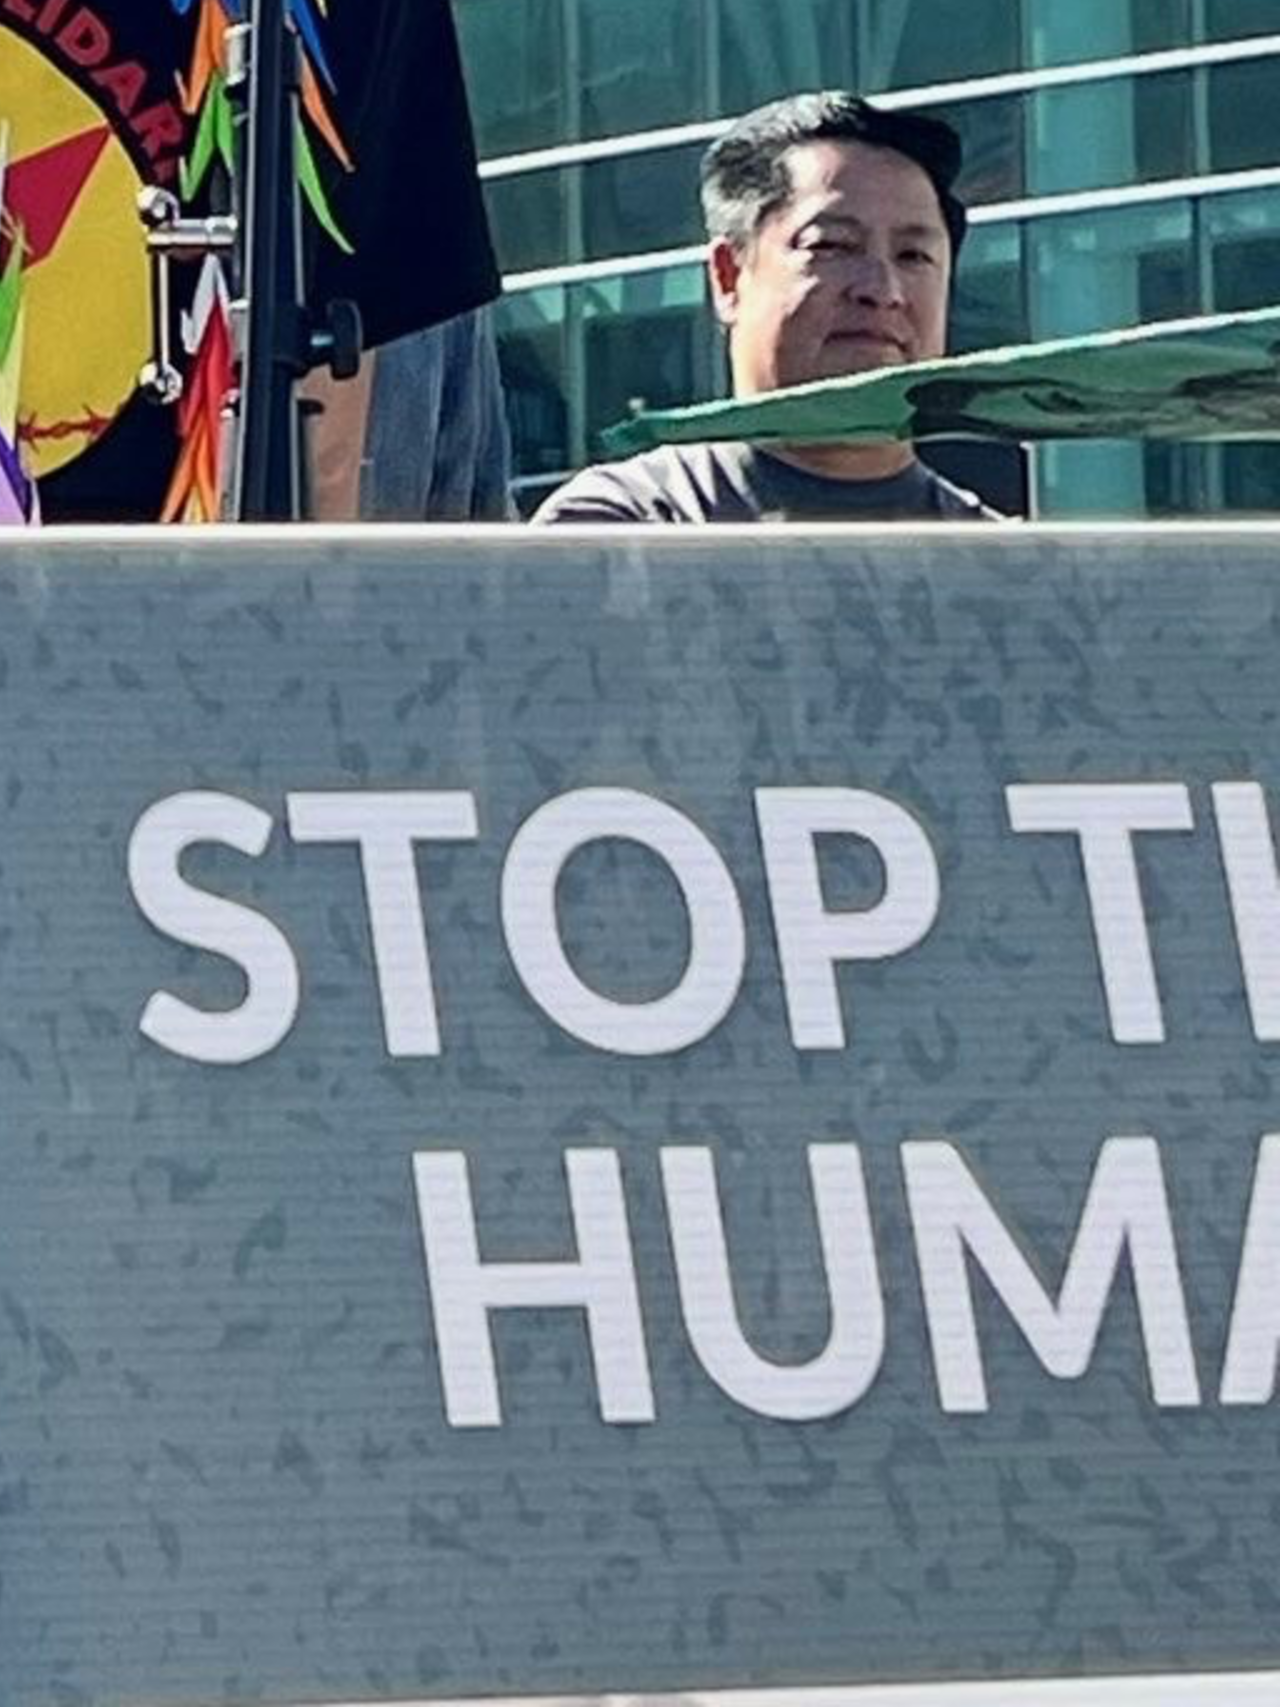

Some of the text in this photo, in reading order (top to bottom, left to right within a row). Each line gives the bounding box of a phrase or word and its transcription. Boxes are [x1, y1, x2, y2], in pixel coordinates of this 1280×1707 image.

[125, 782, 1280, 1064] STOP T
[412, 1132, 1280, 1428] HUM
